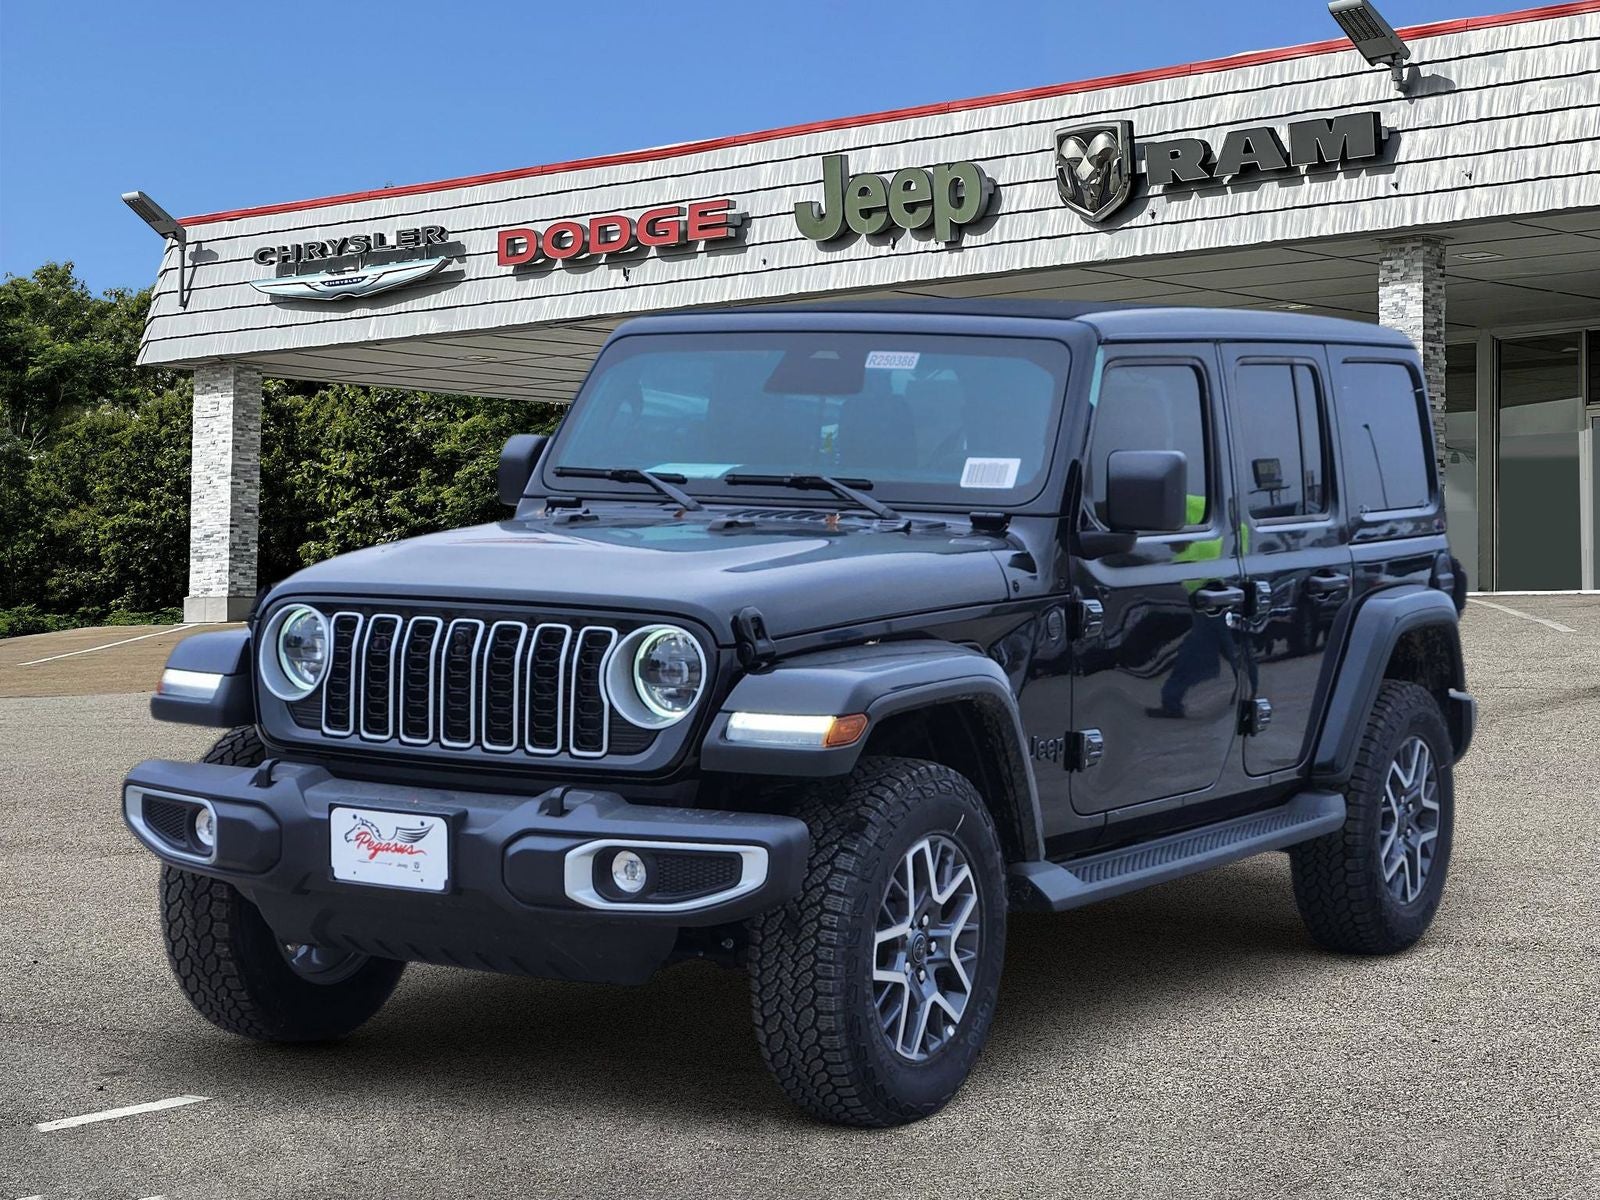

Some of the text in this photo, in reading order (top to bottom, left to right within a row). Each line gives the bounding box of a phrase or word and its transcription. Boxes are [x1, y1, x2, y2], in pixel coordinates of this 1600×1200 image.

[1145, 111, 1382, 187] RAM
[794, 155, 987, 242] Jeep
[253, 225, 449, 266] CHRYSLER
[497, 199, 736, 267] DODGE
[324, 277, 363, 286] CHRYSLER
[355, 830, 428, 861] Pegasus
